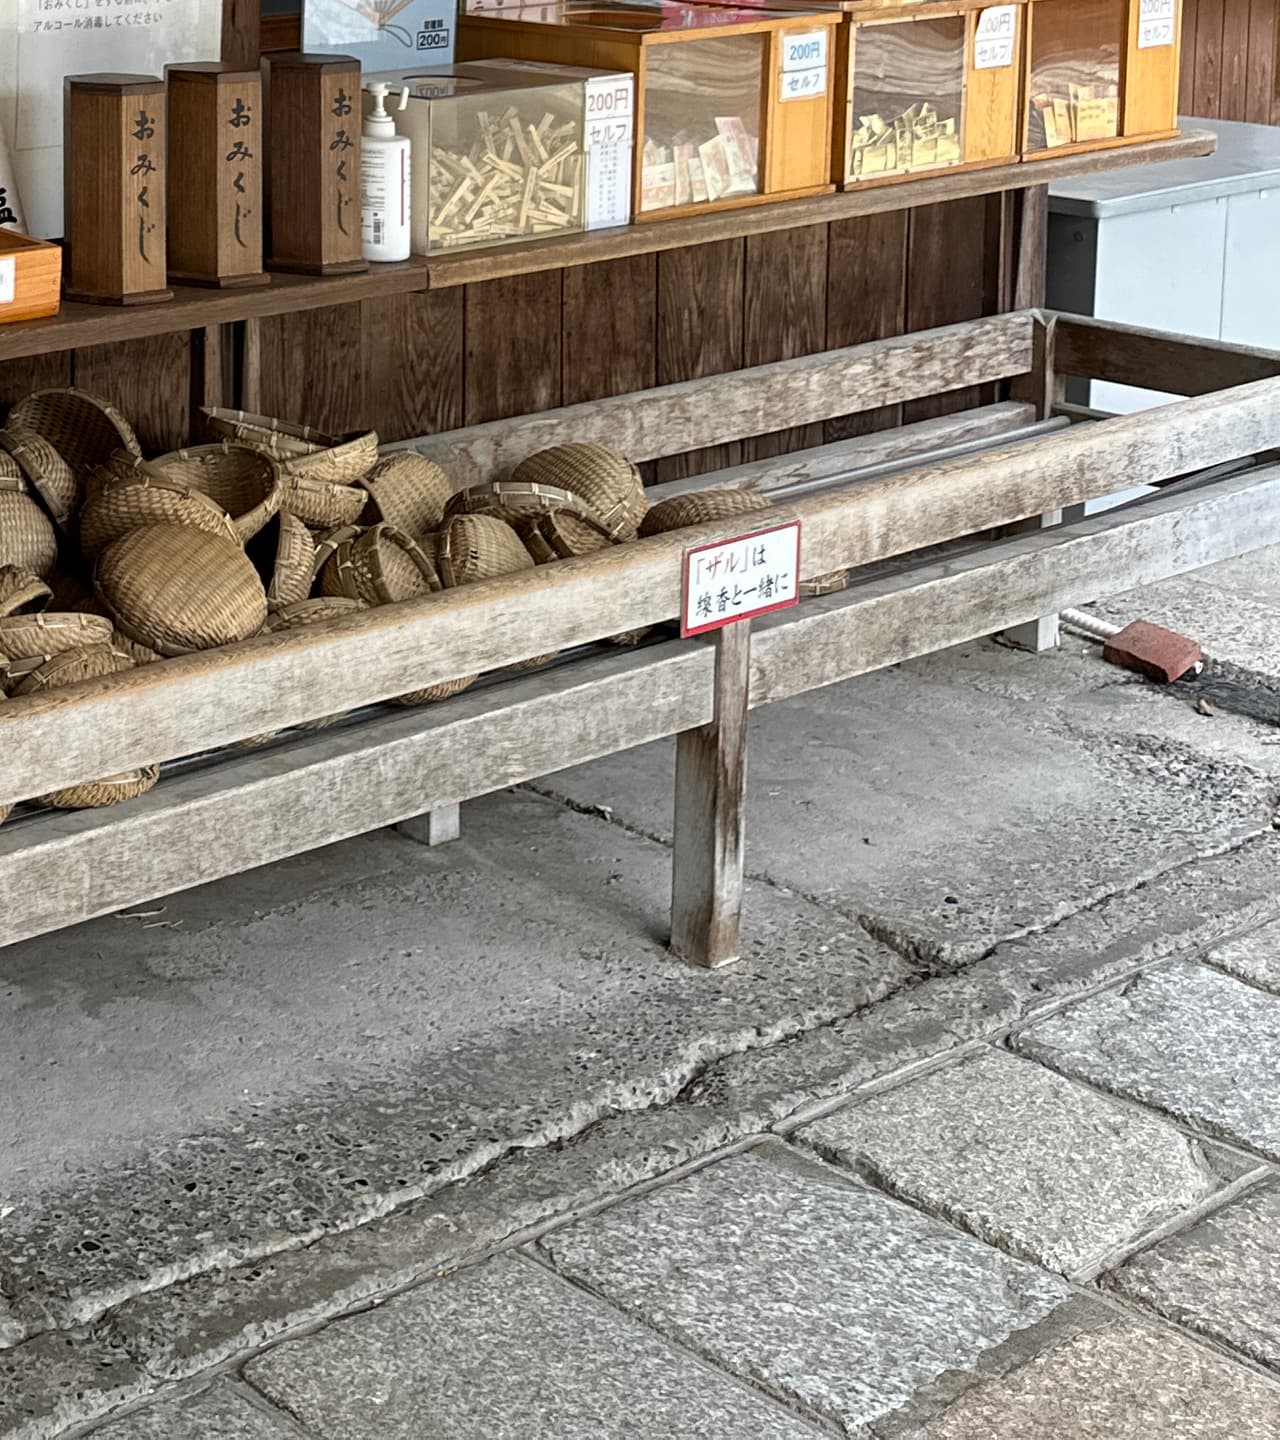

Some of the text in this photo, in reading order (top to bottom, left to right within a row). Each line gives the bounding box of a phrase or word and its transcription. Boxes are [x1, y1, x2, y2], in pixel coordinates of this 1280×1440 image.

[33, 13, 163, 33] アルコール消毒してください
[1143, 24, 1170, 40] セルフ
[789, 40, 820, 61] 200円
[977, 42, 1008, 63] セルフ
[787, 71, 820, 92] セルフ
[588, 89, 628, 111] 200円
[590, 124, 628, 144] セルフ
[225, 98, 253, 248] おみくじ
[329, 88, 354, 237] おみくじ
[130, 110, 157, 264] おみくじ
[697, 544, 768, 585] 「ザル」は
[696, 573, 788, 617] 線香と一緒に
